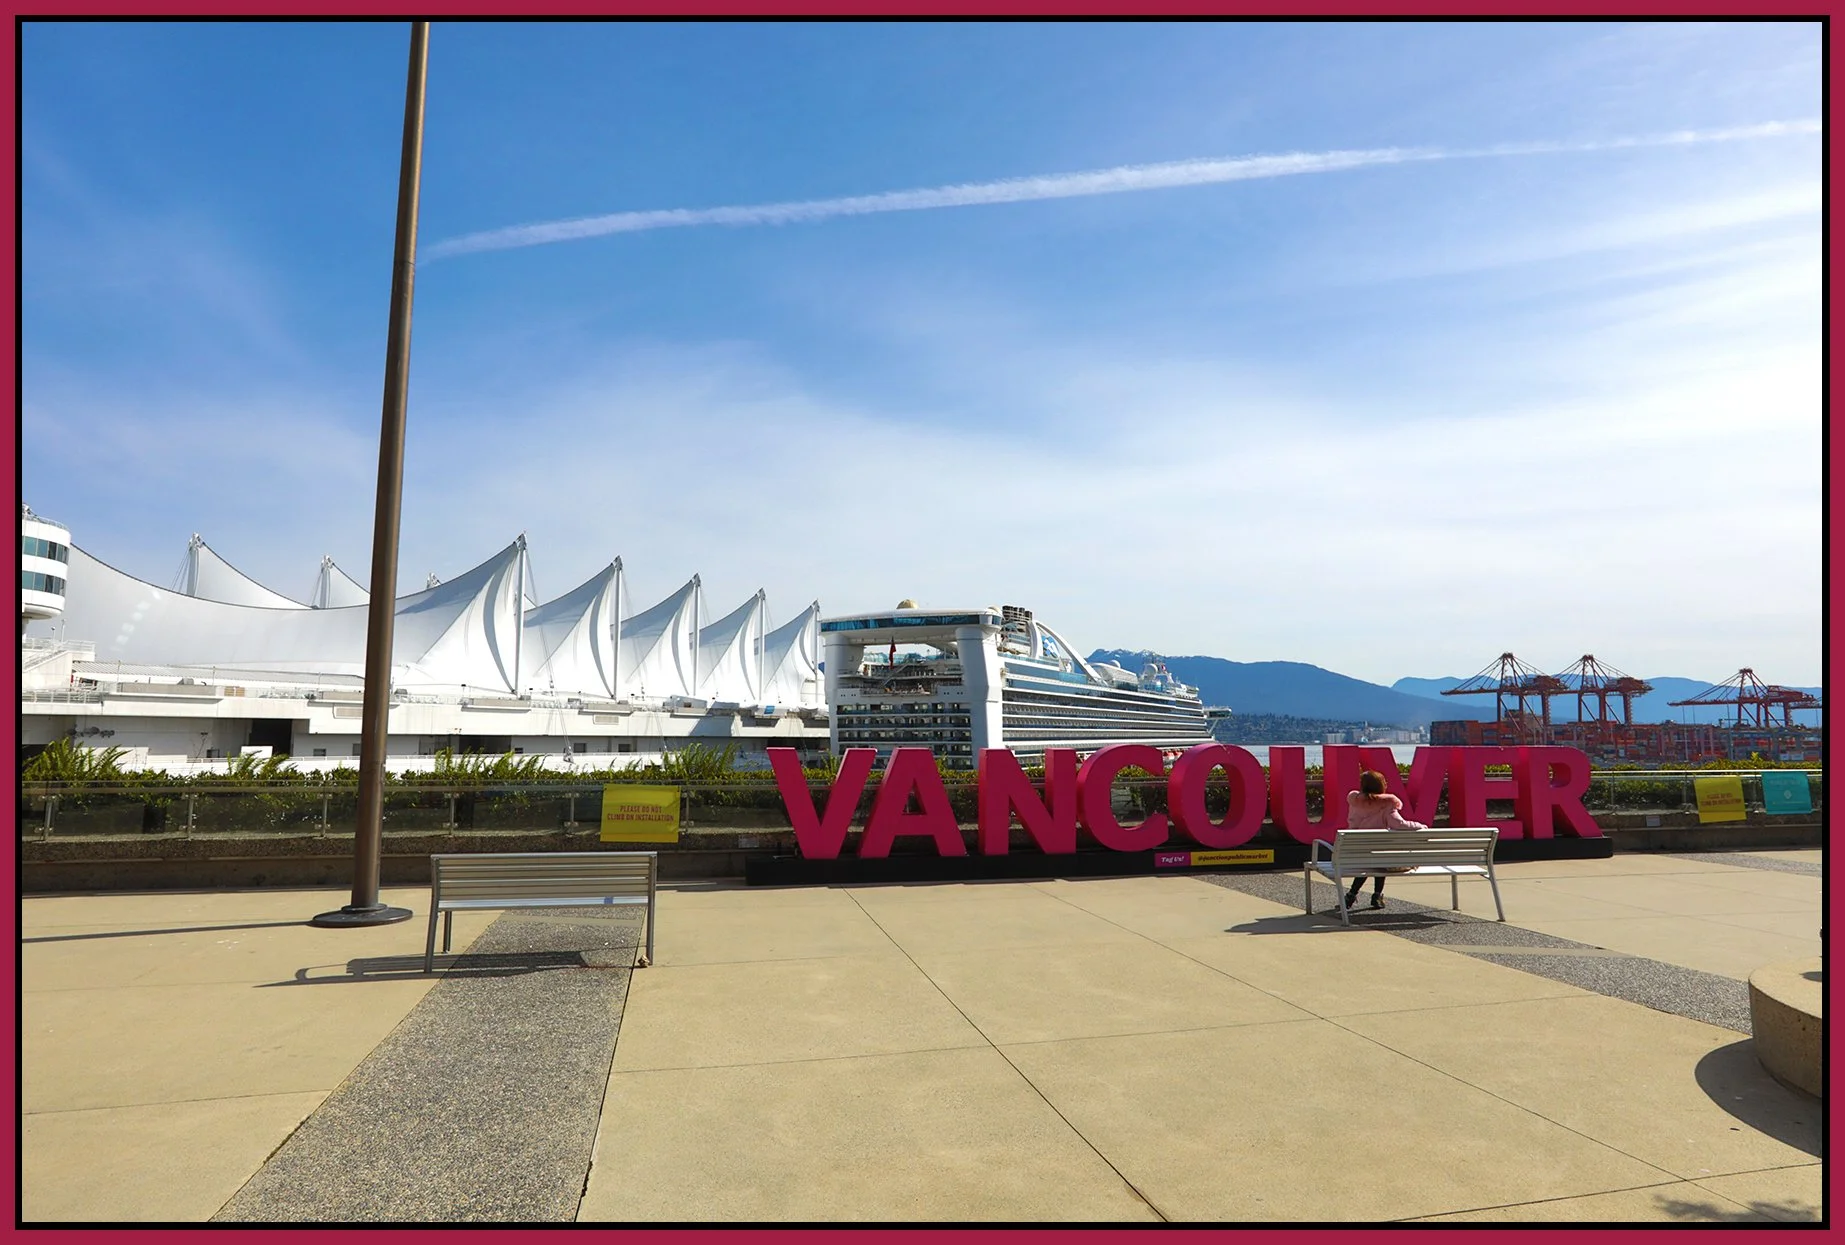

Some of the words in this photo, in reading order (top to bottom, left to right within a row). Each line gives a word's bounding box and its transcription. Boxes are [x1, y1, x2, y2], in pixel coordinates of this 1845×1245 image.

[766, 743, 1604, 860] VANCOUVER
[619, 805, 640, 813] PLEASE
[641, 805, 650, 813] DO
[651, 805, 662, 814] NOT
[607, 813, 625, 821] CLIMB
[625, 813, 634, 821] ON
[635, 814, 674, 822] INSTALLATION
